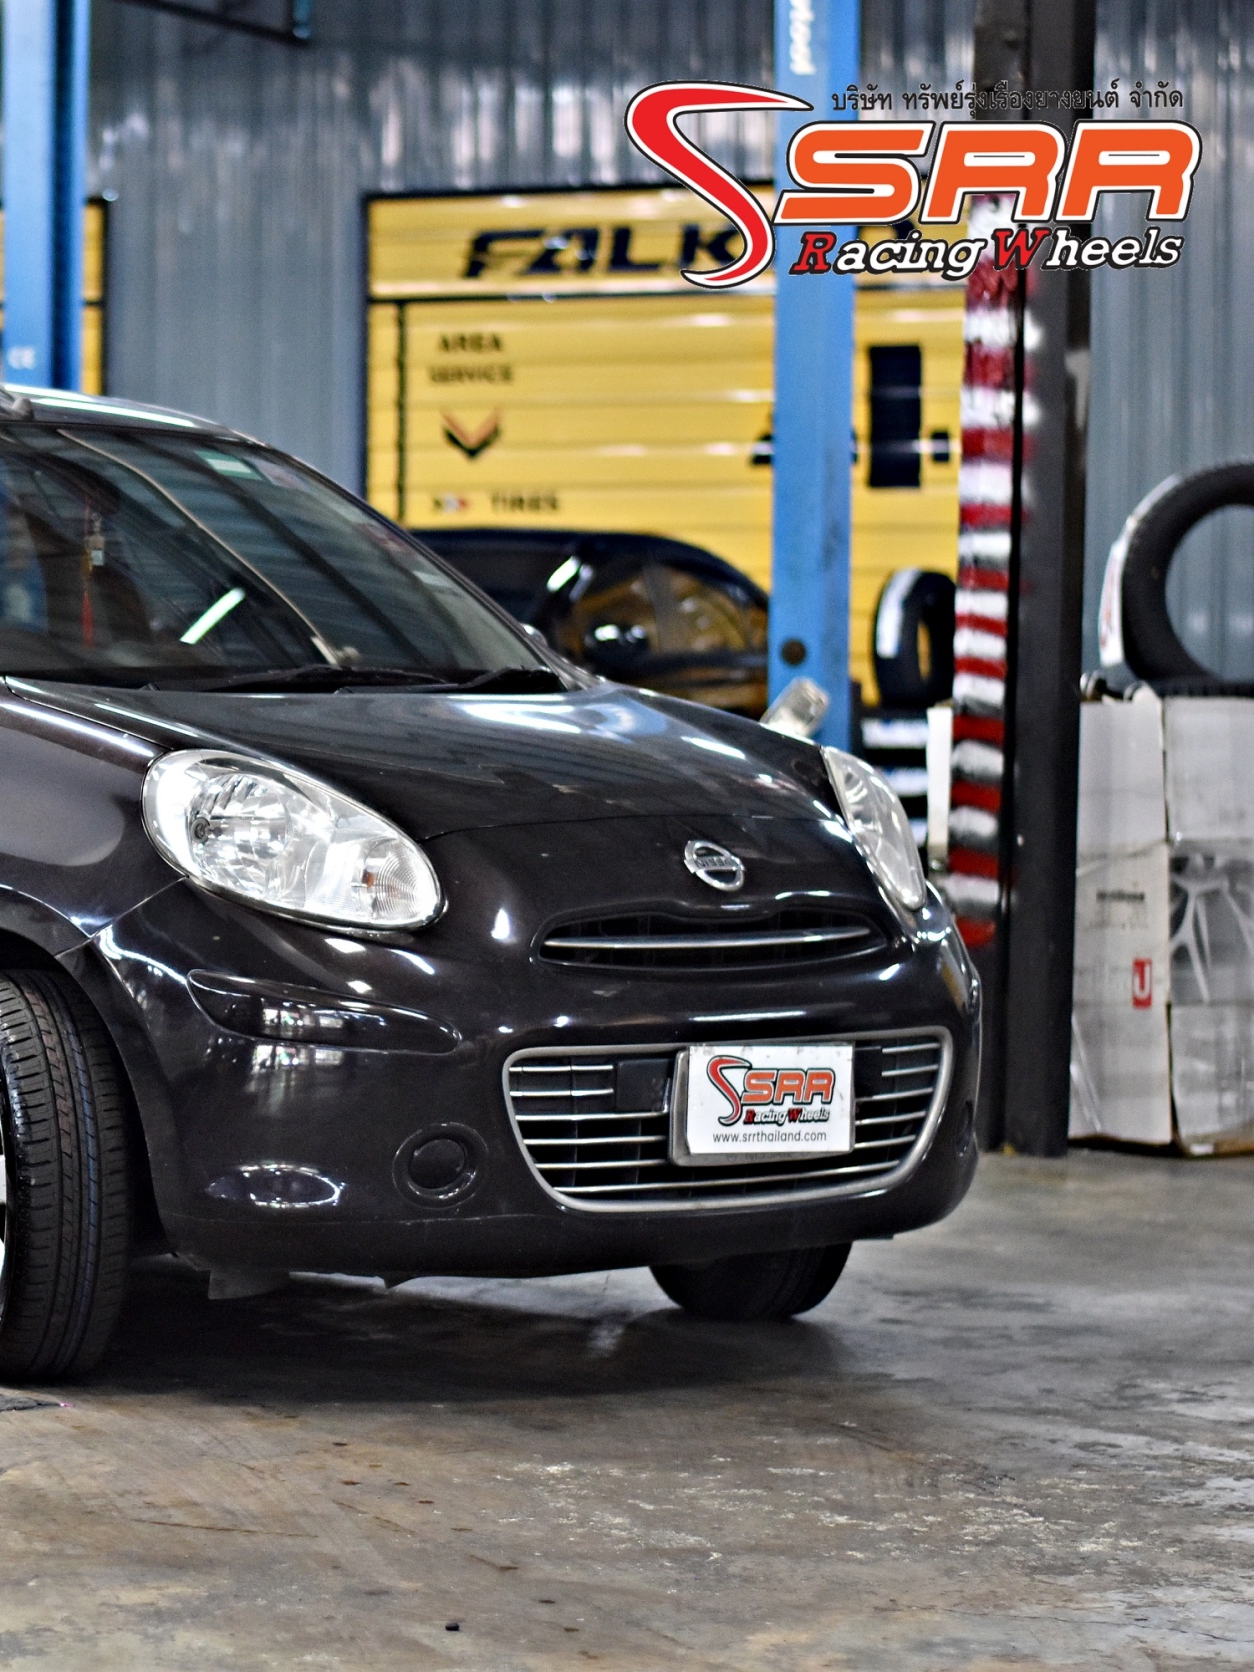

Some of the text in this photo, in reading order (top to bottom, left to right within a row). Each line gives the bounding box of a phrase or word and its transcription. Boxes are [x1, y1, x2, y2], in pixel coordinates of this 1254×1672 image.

[437, 333, 503, 352] AREA
[429, 364, 513, 385] SERVICE
[491, 495, 558, 513] TIRES
[743, 1106, 831, 1126] Racing Wheels
[713, 1130, 827, 1143] www.srrthailand.com
